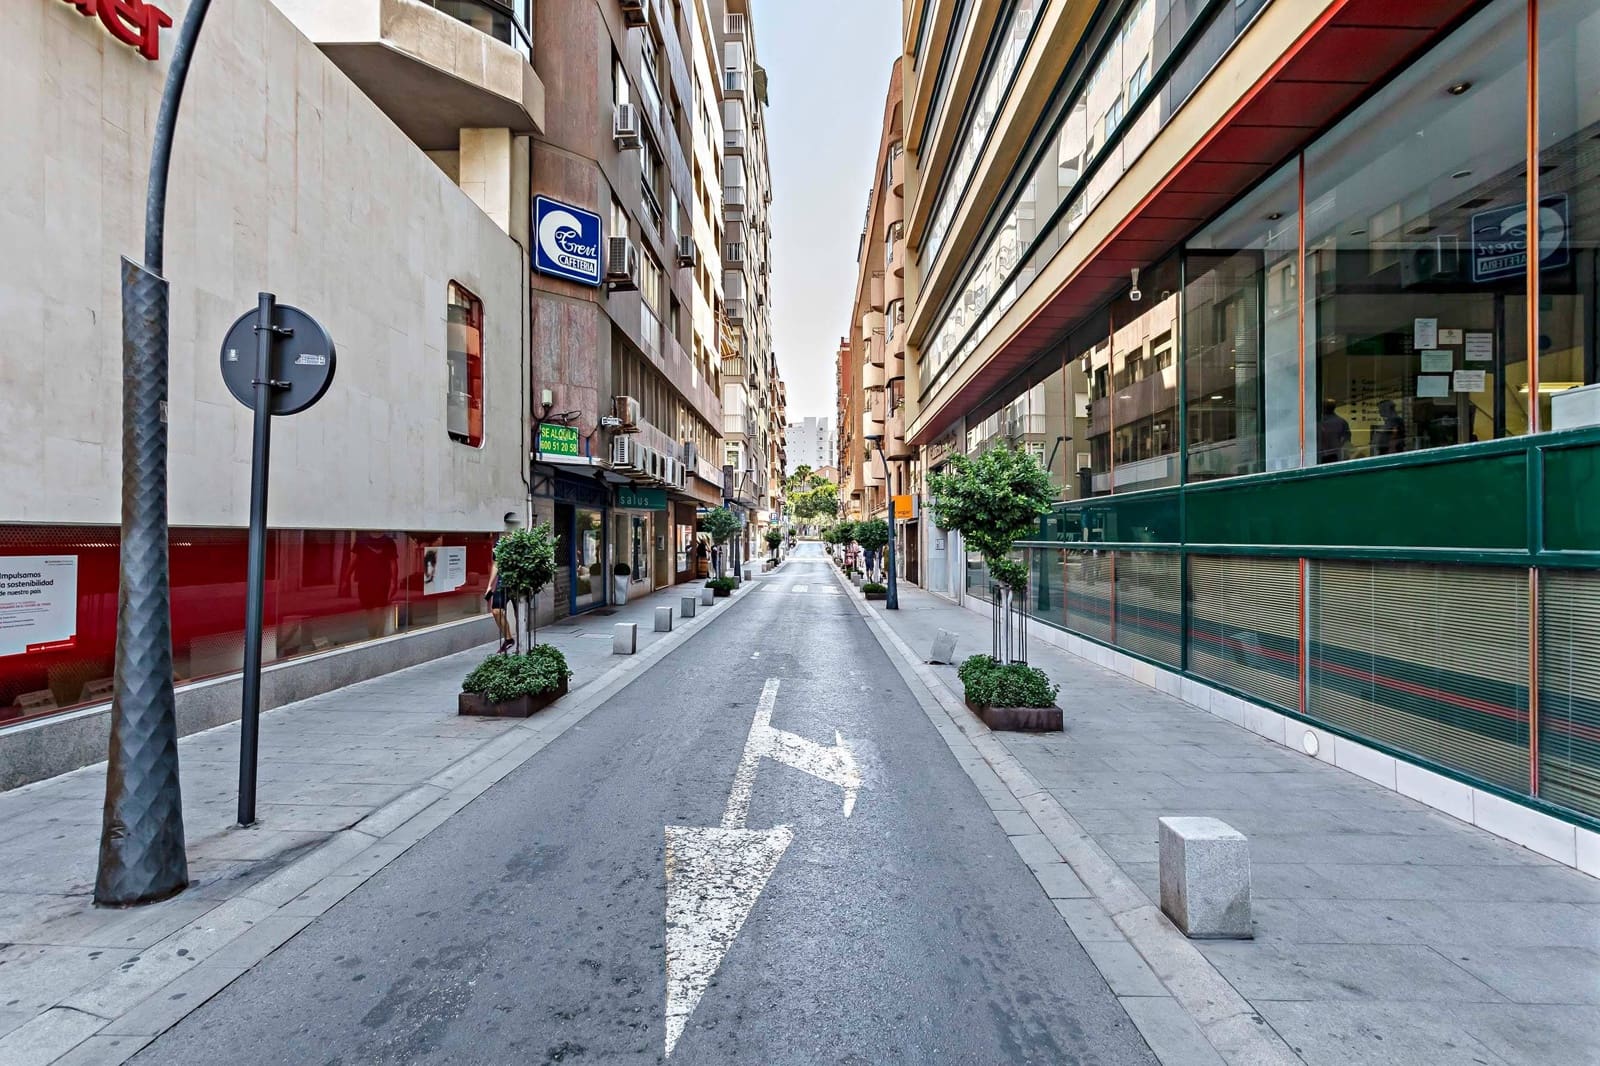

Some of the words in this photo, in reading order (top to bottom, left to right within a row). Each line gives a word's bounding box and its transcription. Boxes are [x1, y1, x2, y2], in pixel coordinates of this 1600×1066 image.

[555, 231, 597, 256] Trevi
[559, 255, 594, 273] CAFETERIA
[541, 427, 550, 437] SE
[551, 428, 577, 441] ALQUILA
[541, 440, 551, 450] 600
[552, 441, 559, 451] 51
[561, 442, 568, 452] 20
[569, 443, 577, 453] 58
[620, 494, 649, 506] salus
[7, 579, 54, 588] sostenibilidad
